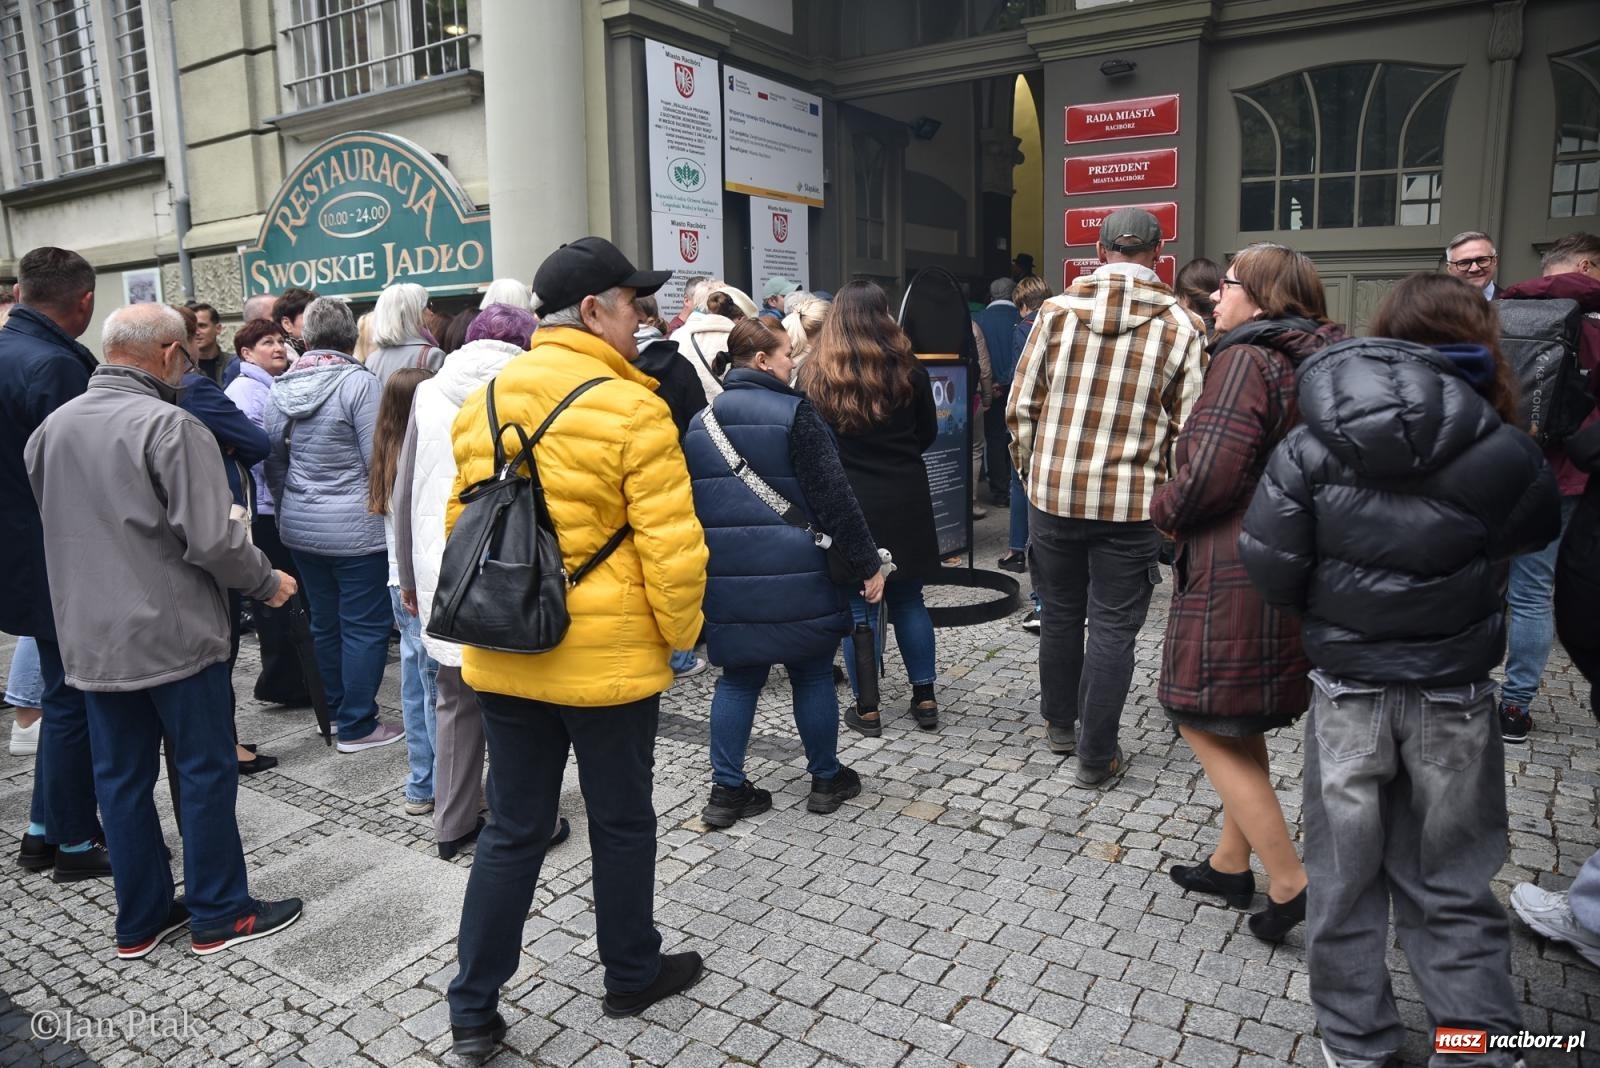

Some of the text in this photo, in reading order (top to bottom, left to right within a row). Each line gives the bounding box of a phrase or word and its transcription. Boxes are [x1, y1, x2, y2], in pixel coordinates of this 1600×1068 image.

[665, 51, 701, 67] Miasto Racibórz
[1086, 108, 1156, 124] RADA MIASTA
[1105, 123, 1136, 131] RACIBÓRZ
[1088, 161, 1150, 176] PREZYDENT
[1092, 174, 1145, 184] MIASTA RACIBÓRZ
[275, 148, 437, 247] RESTAURACJA
[686, 220, 707, 230] Racibórz
[1081, 218, 1103, 228] URZ
